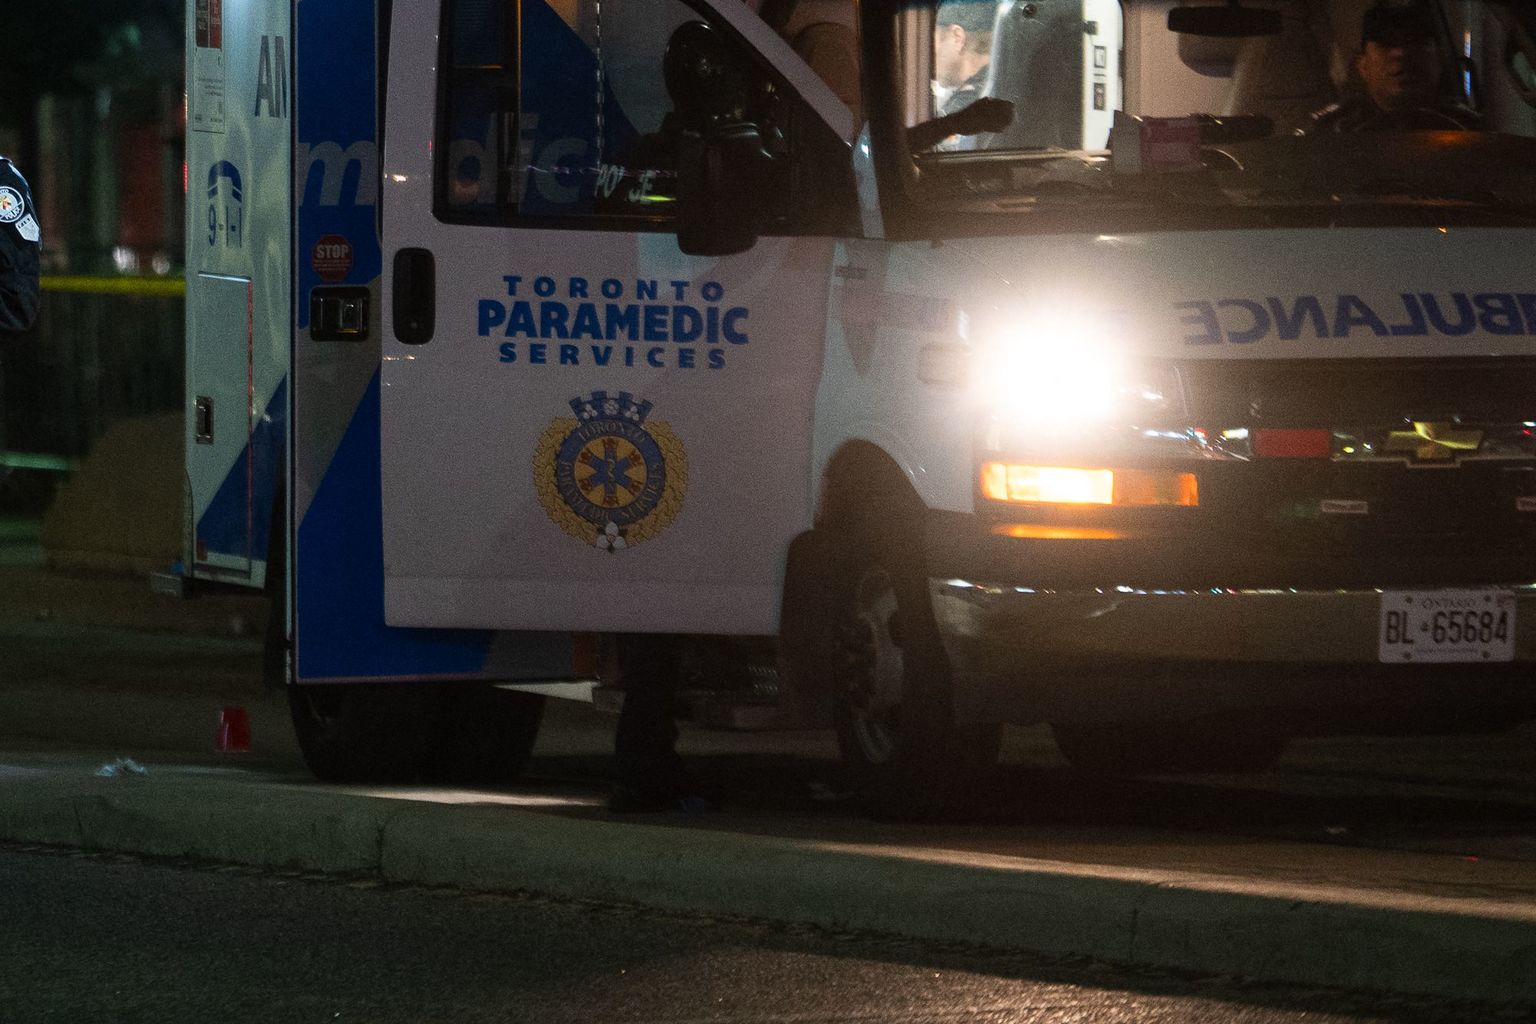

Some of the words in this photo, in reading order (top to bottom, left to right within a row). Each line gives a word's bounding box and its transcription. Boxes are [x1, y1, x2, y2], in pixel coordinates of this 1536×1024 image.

[299, 112, 590, 207] mdic
[316, 243, 350, 259] STOP
[503, 276, 725, 303] TORONTO
[477, 299, 750, 346] PARAMEDIC
[499, 342, 726, 369] SERVICES
[1386, 611, 1414, 644] BL
[1433, 611, 1508, 644] 65684
